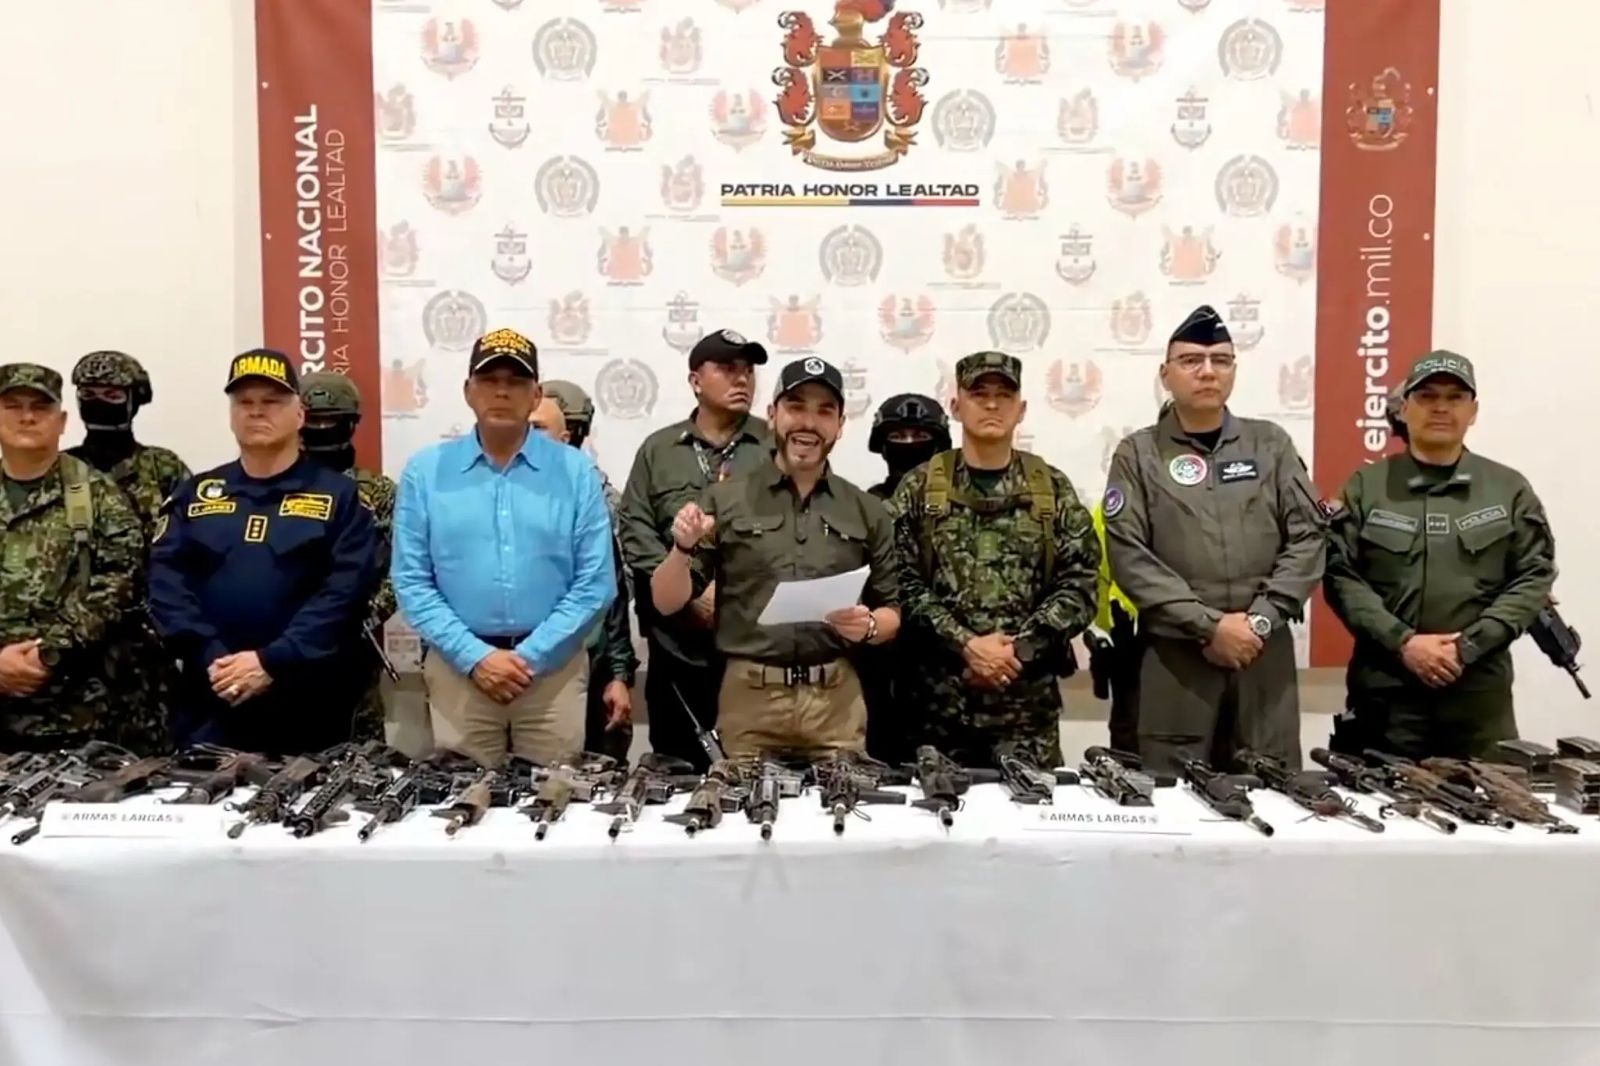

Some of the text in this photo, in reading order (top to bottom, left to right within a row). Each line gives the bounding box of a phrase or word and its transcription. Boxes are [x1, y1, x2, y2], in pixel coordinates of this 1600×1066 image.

[324, 128, 347, 232] LEALTAD
[720, 183, 980, 197] PATRIA HONOR LEALTAD
[293, 103, 326, 377] RCITO NACIONAL
[328, 243, 350, 334] HONOR
[233, 355, 286, 380] ARMADA
[1050, 813, 1147, 824] ARMAS LARGAS
